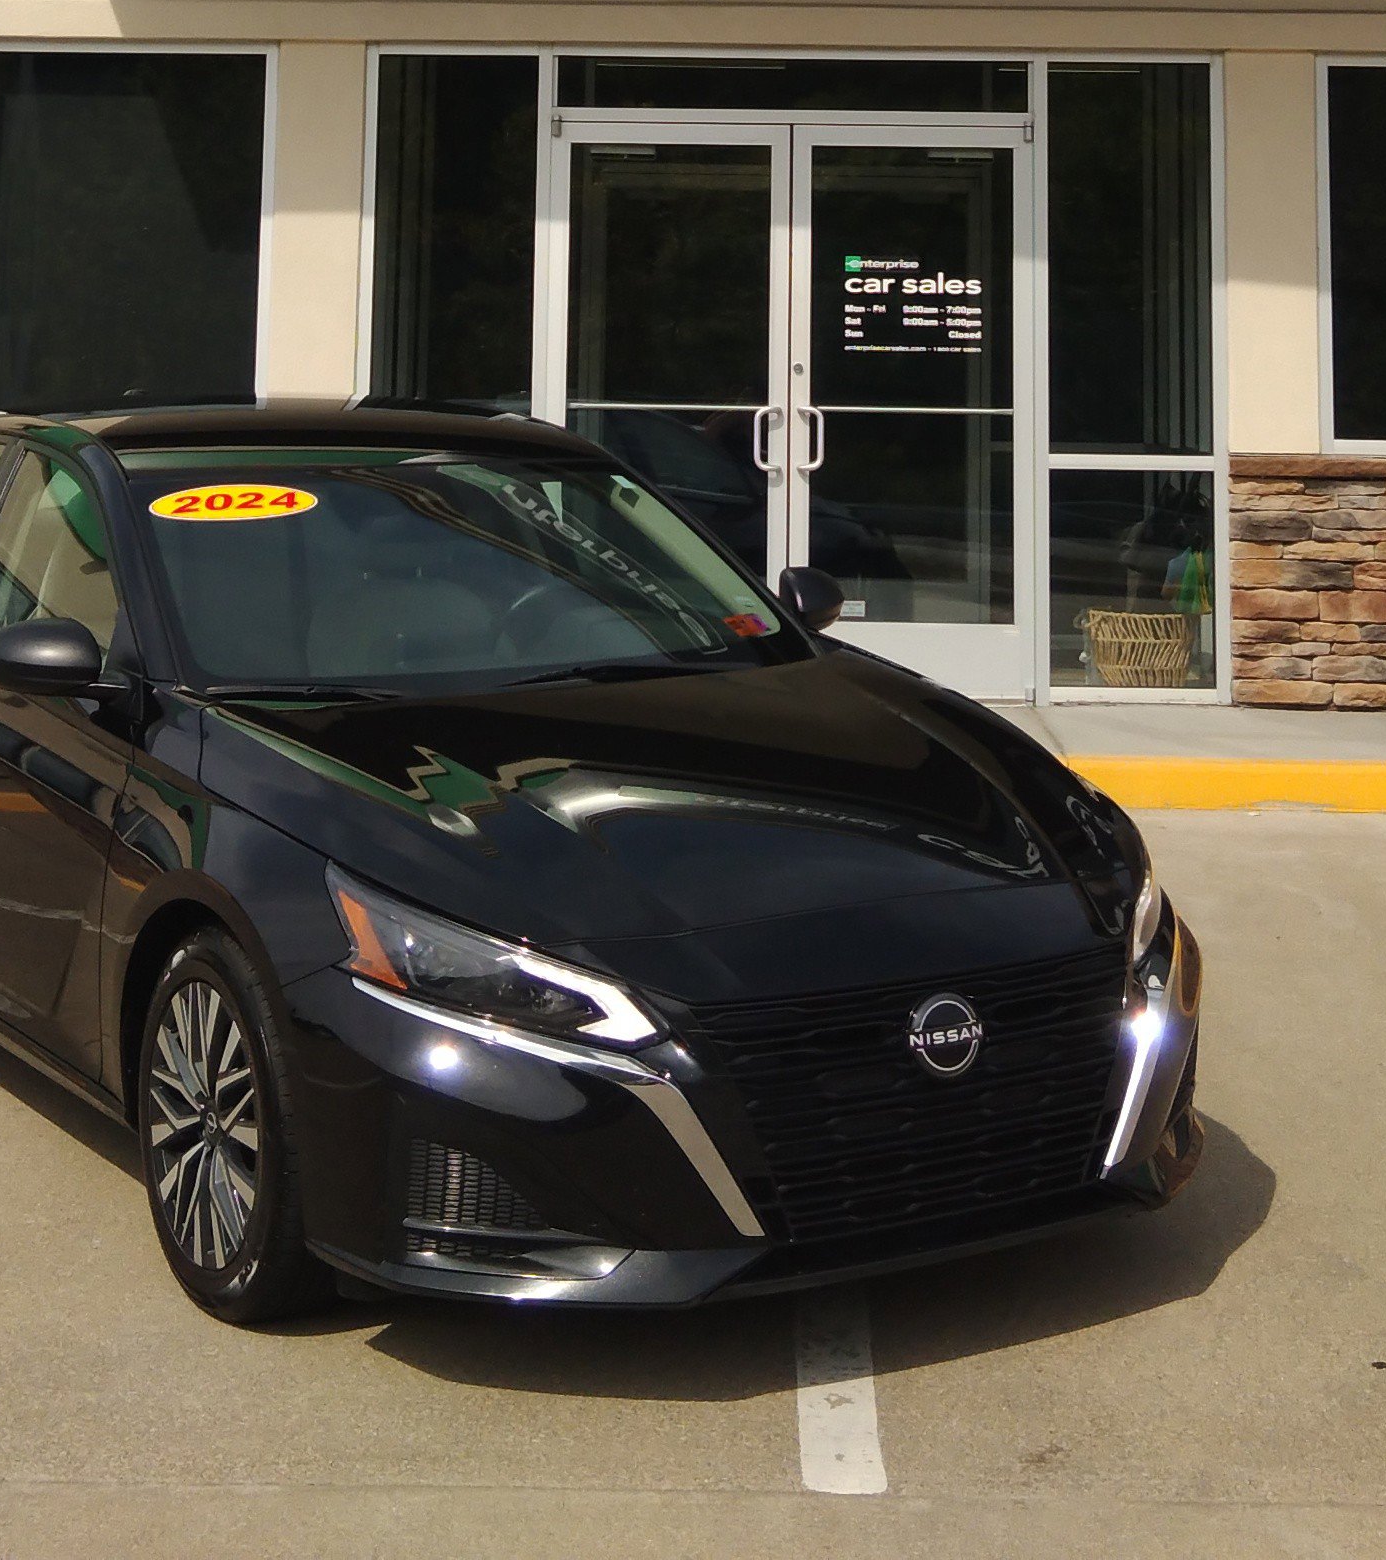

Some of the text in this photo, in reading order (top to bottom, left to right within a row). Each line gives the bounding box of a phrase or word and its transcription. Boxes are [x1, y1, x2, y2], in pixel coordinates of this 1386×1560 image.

[845, 258, 920, 271] enterprise
[844, 272, 982, 295] car sales
[844, 328, 983, 340] Sun Closed
[171, 491, 299, 515] 2024
[909, 1023, 983, 1047] NISSAN
